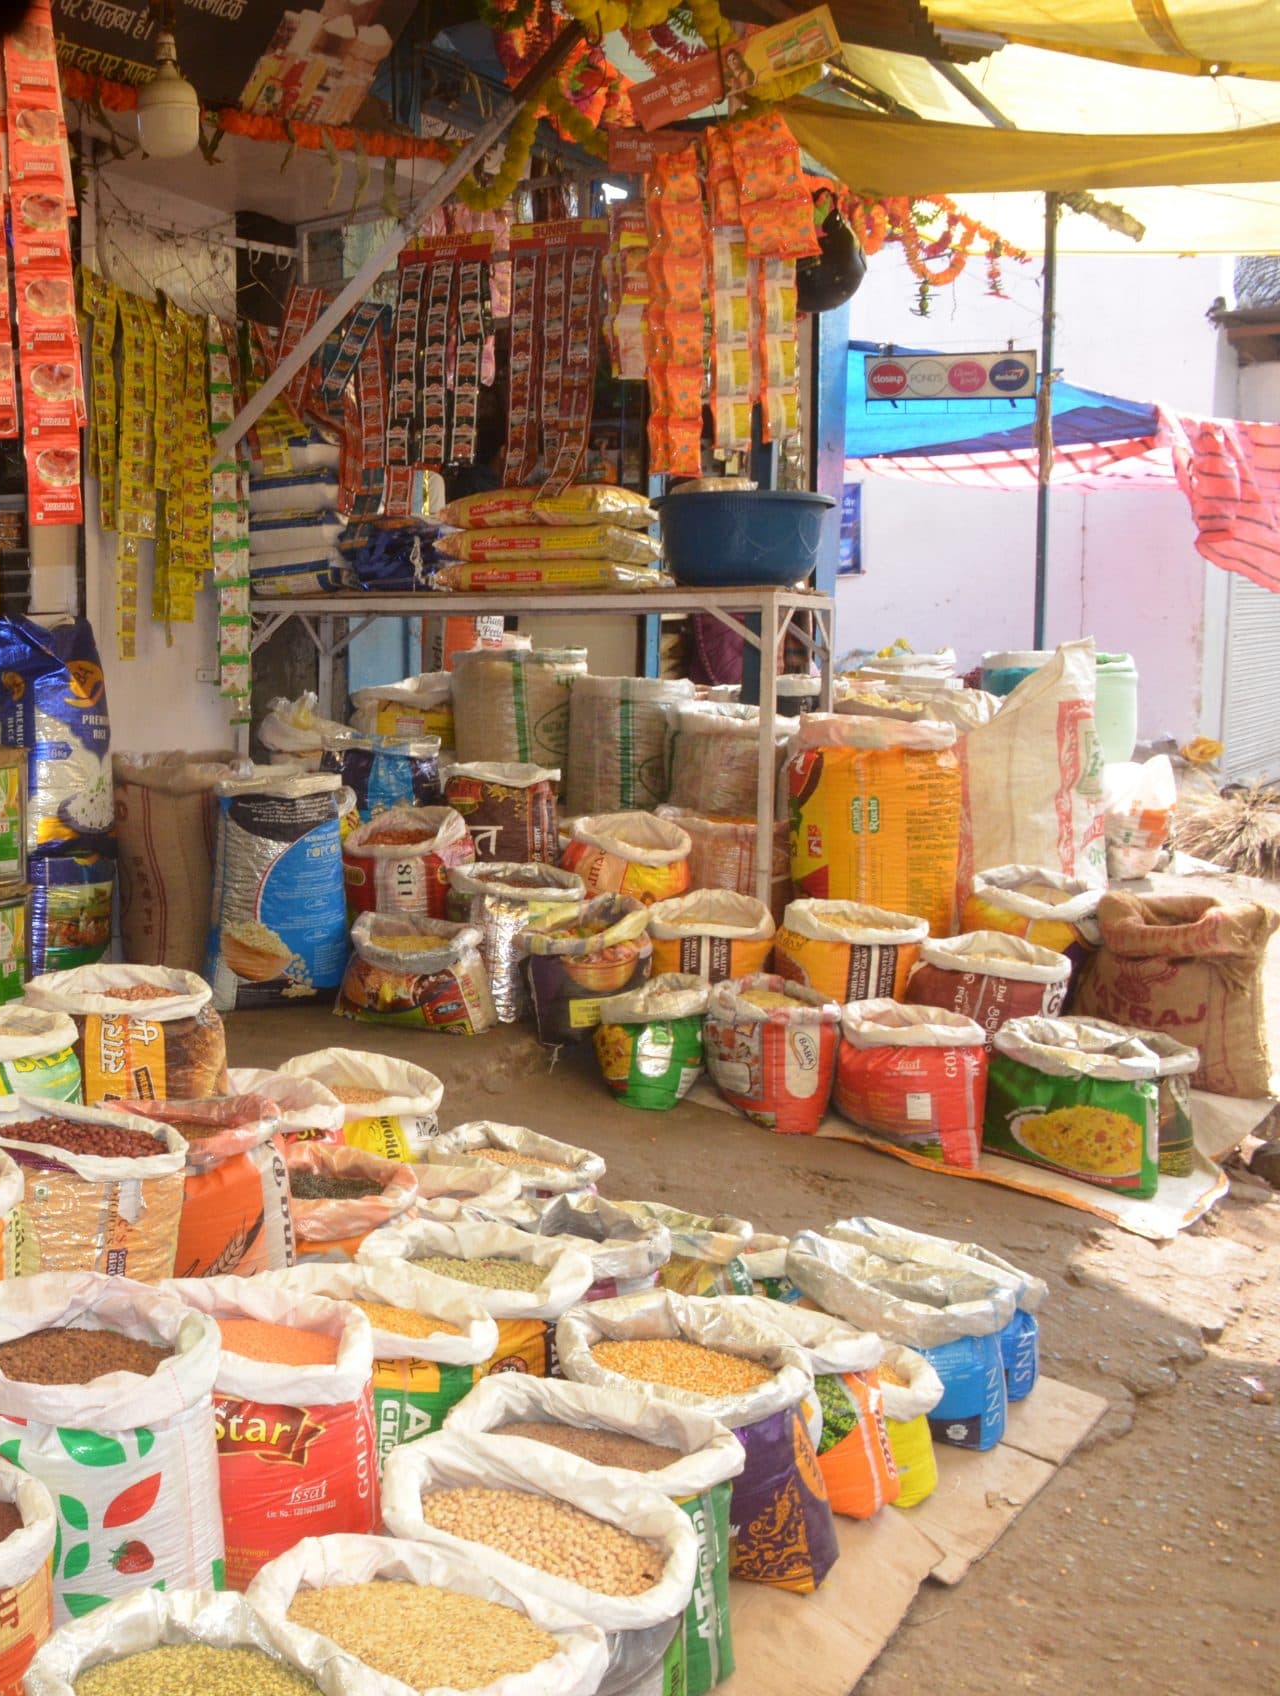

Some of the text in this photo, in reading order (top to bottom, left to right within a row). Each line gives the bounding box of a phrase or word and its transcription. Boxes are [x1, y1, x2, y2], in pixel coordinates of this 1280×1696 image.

[423, 234, 473, 248] SUNRISE
[532, 222, 582, 236] SUNRISE
[306, 844, 338, 858] POPCO
[798, 1036, 815, 1065] BABA
[1014, 1332, 1037, 1383] NNS
[986, 1367, 1000, 1426] NNS
[355, 1425, 370, 1499] GOLD
